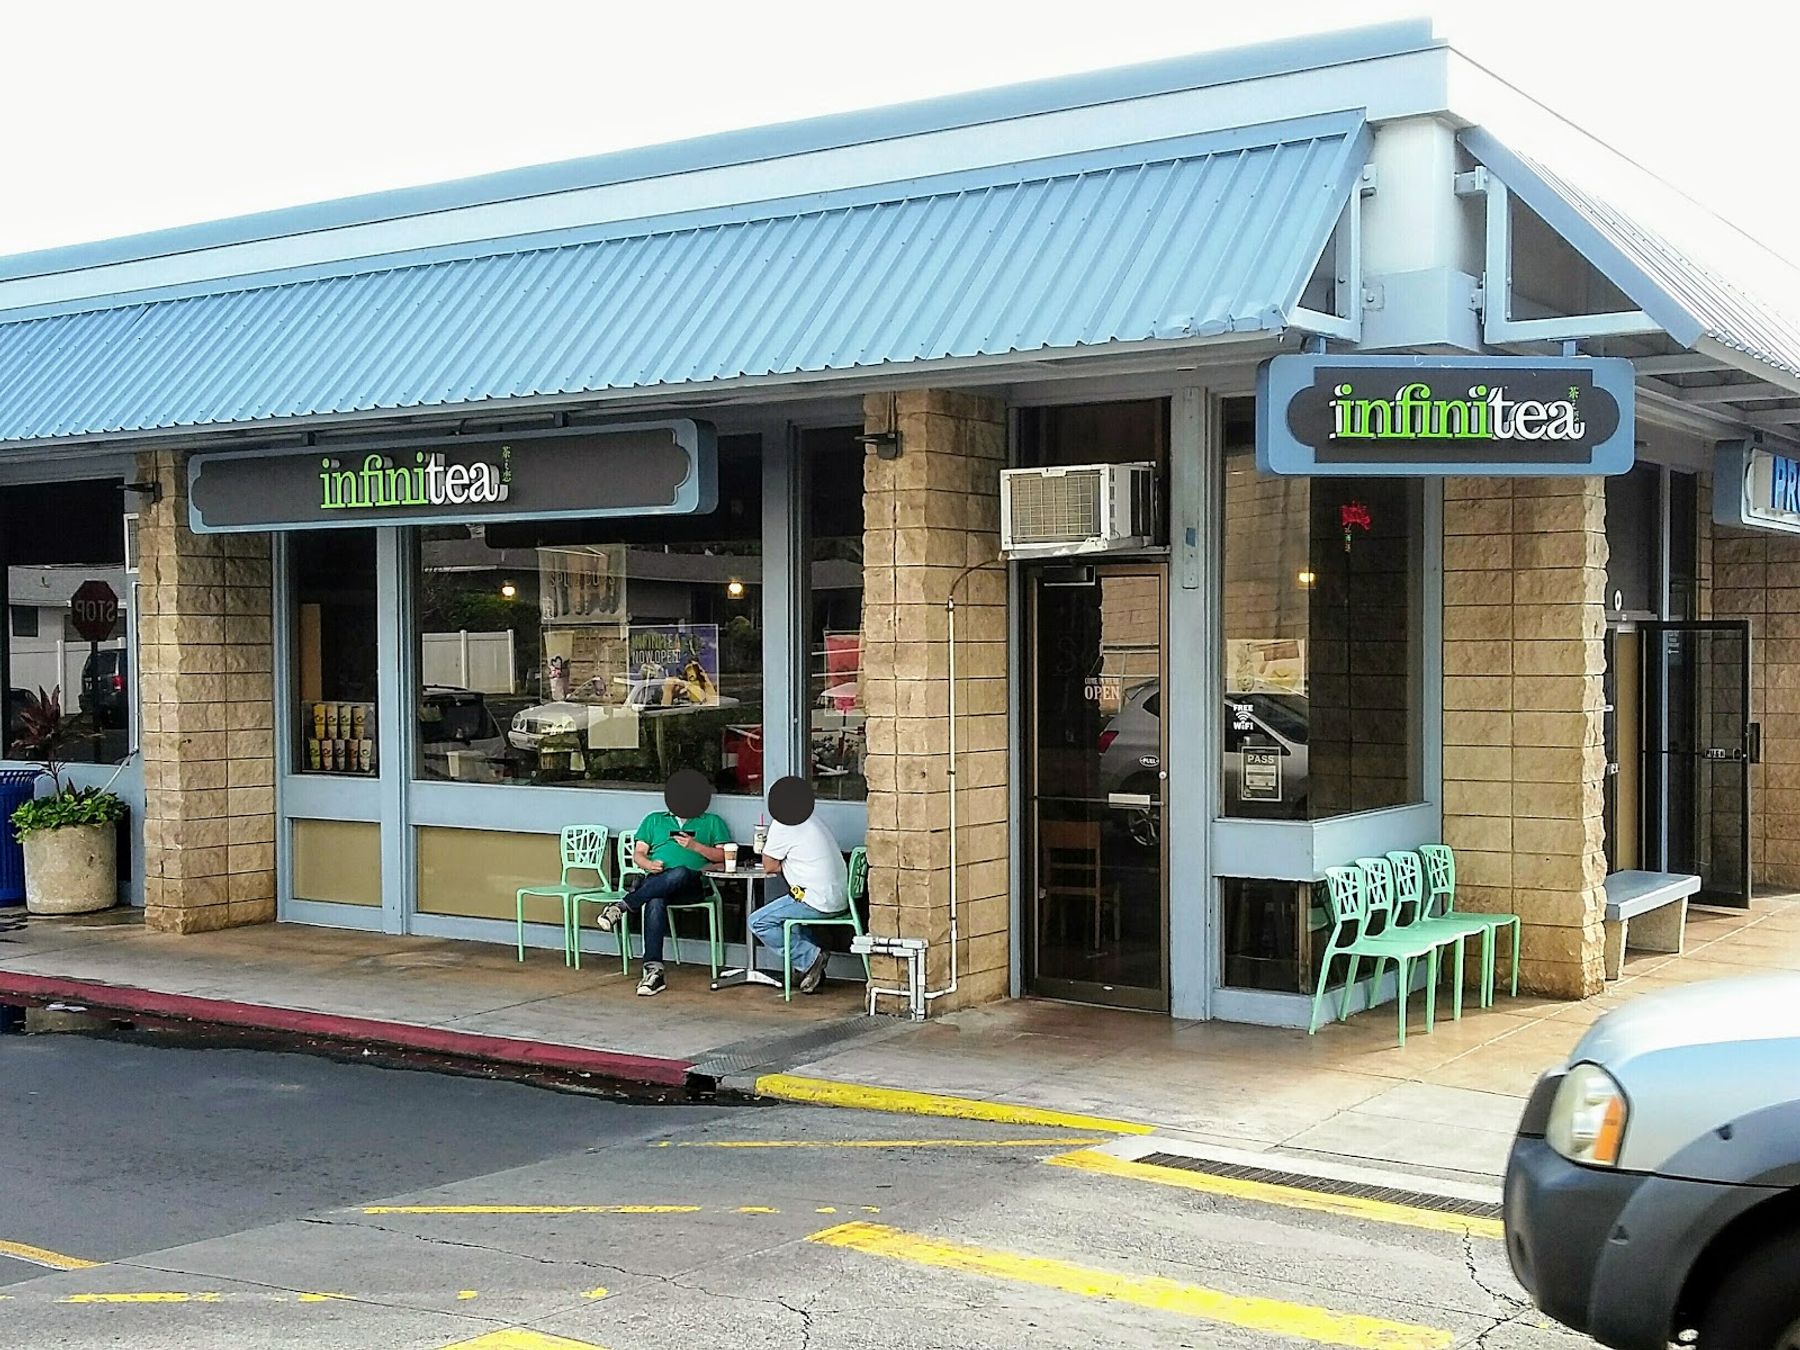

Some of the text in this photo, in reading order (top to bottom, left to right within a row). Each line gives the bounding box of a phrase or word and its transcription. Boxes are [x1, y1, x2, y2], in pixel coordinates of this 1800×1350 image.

[1329, 383, 1585, 440] infinitea
[319, 451, 500, 509] infinitea
[1773, 455, 1800, 513] PR
[1084, 685, 1120, 700] OPEN
[1233, 704, 1254, 712] FREE
[1247, 755, 1275, 764] PASS
